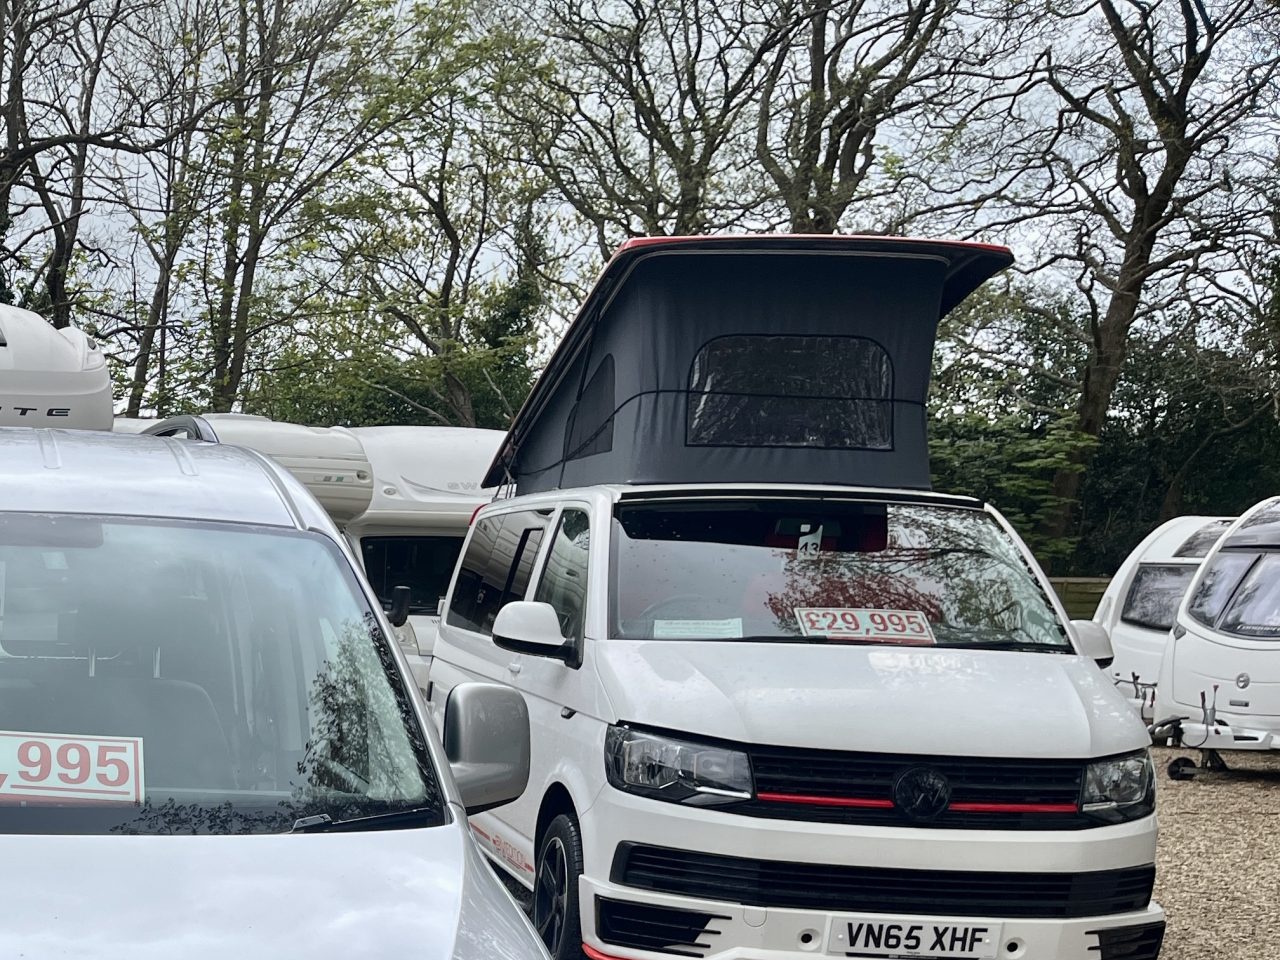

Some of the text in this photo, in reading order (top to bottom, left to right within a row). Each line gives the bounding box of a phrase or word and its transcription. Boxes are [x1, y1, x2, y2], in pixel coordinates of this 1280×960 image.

[805, 611, 926, 636] £29,995
[847, 922, 988, 952] VN65 XHF
